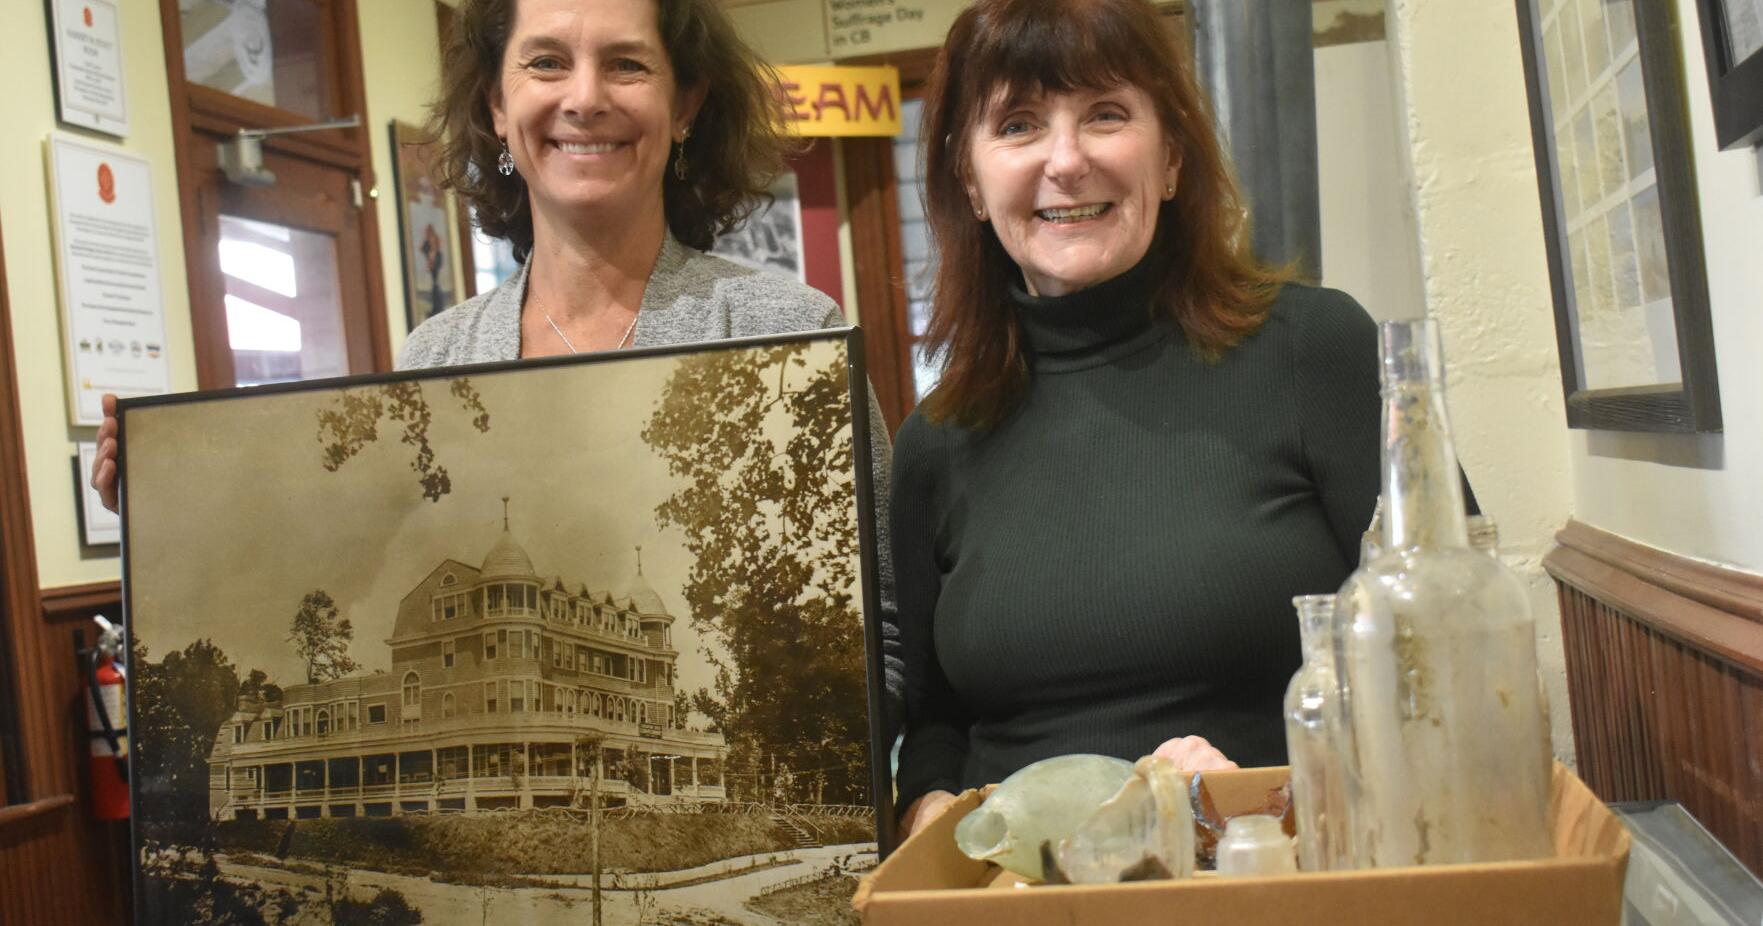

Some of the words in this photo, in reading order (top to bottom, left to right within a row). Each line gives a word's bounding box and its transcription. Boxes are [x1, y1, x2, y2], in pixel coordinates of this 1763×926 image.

[831, 0, 894, 11] Womens
[832, 13, 892, 29] Suffrage
[896, 7, 924, 21] Day
[833, 34, 847, 46] in
[850, 29, 871, 45] CB
